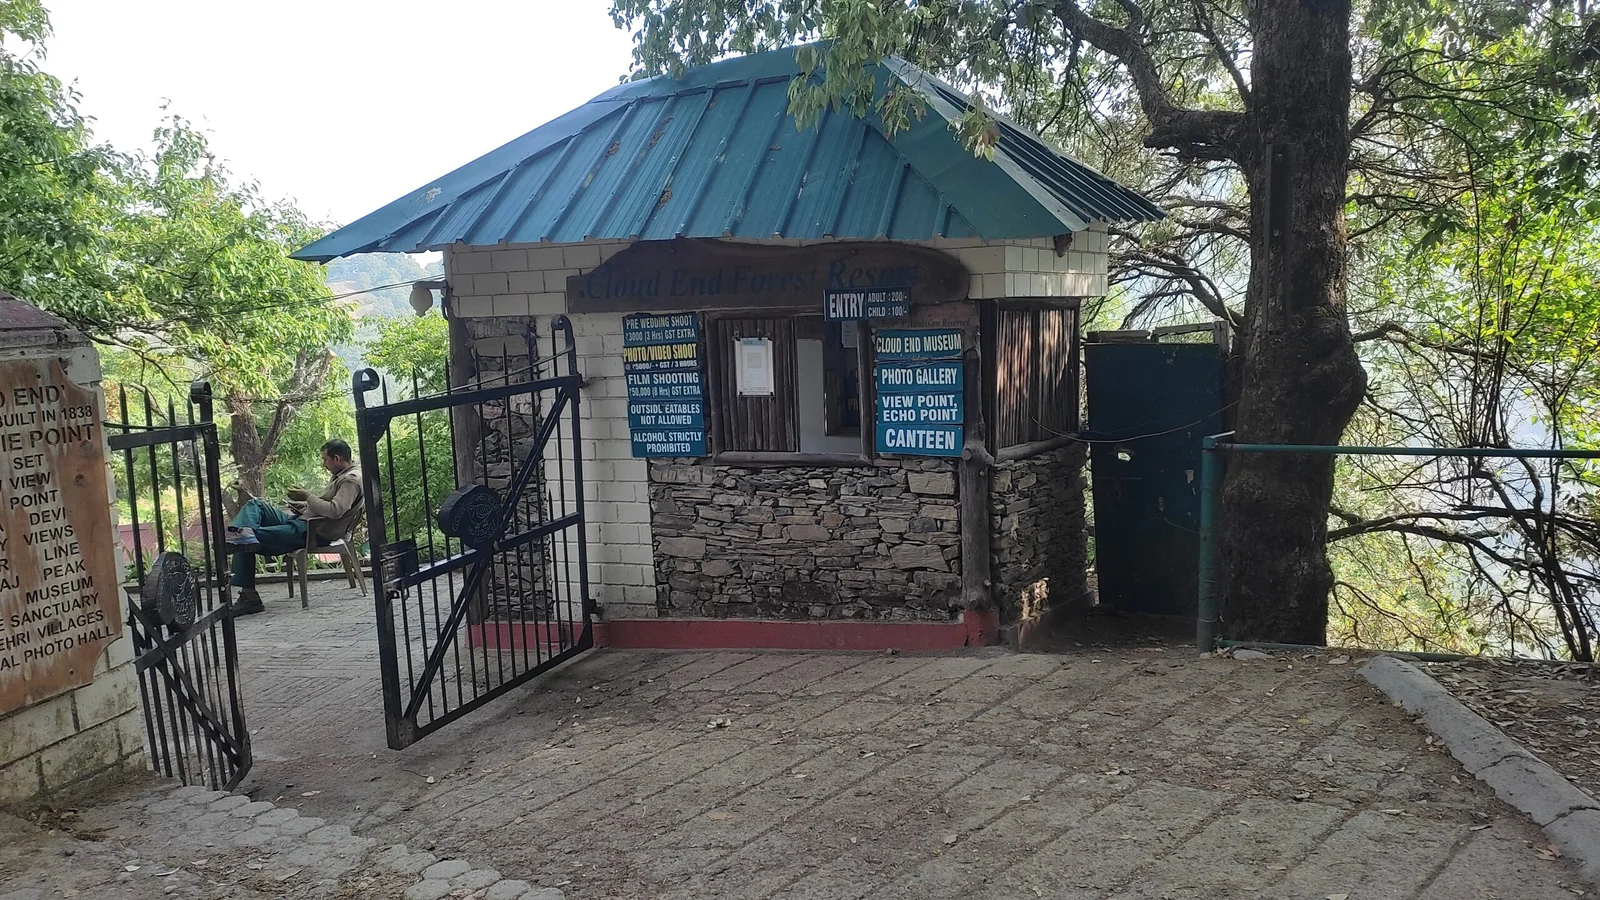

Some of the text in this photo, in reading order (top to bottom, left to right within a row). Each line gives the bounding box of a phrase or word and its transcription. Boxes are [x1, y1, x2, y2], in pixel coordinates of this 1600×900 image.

[585, 268, 661, 300] Cloud
[670, 267, 723, 297] End
[731, 263, 818, 295] Forest
[829, 293, 865, 318] ENTRY
[867, 292, 886, 303] ADULT
[867, 307, 886, 317] CHILD
[626, 315, 693, 330] PRE WEDDING SHOOT
[664, 329, 676, 339] GST
[677, 328, 696, 339] EXTRA
[876, 333, 962, 353] CLOUD END MUSEUM
[623, 343, 697, 362] PHOTO/VIDEO SHOOT
[659, 361, 670, 369] GST
[679, 359, 698, 368] HOURS
[628, 372, 699, 385] FILM SHOOTING
[881, 368, 957, 385] PHOTO GALLERY
[671, 386, 682, 396] GST
[683, 385, 701, 395] EXTRA
[664, 404, 701, 414] EATABLES
[882, 394, 958, 408] VIEW POINT,
[42, 409, 56, 423] IN
[61, 405, 93, 420] 1838
[640, 415, 692, 425] NOT ALLOWED
[883, 408, 958, 422] ECHO POINT
[29, 423, 94, 449] POINT
[633, 431, 703, 442] ALCOHOL STRICTLY
[885, 428, 956, 450] CANTEEN
[646, 442, 691, 453] PROHIBITED
[13, 453, 44, 470] SET
[9, 472, 51, 490] VIEW
[10, 489, 58, 510] POINT
[29, 506, 66, 526] DEVI
[23, 524, 74, 546] VIEWS
[44, 541, 80, 562] LINE
[43, 559, 86, 581] PEAK
[25, 576, 94, 604] MUSEUM
[10, 592, 99, 628] SANCTUARY
[37, 610, 104, 639] VILLAGES
[24, 637, 74, 663] PHOTO
[78, 626, 114, 646] HALL
